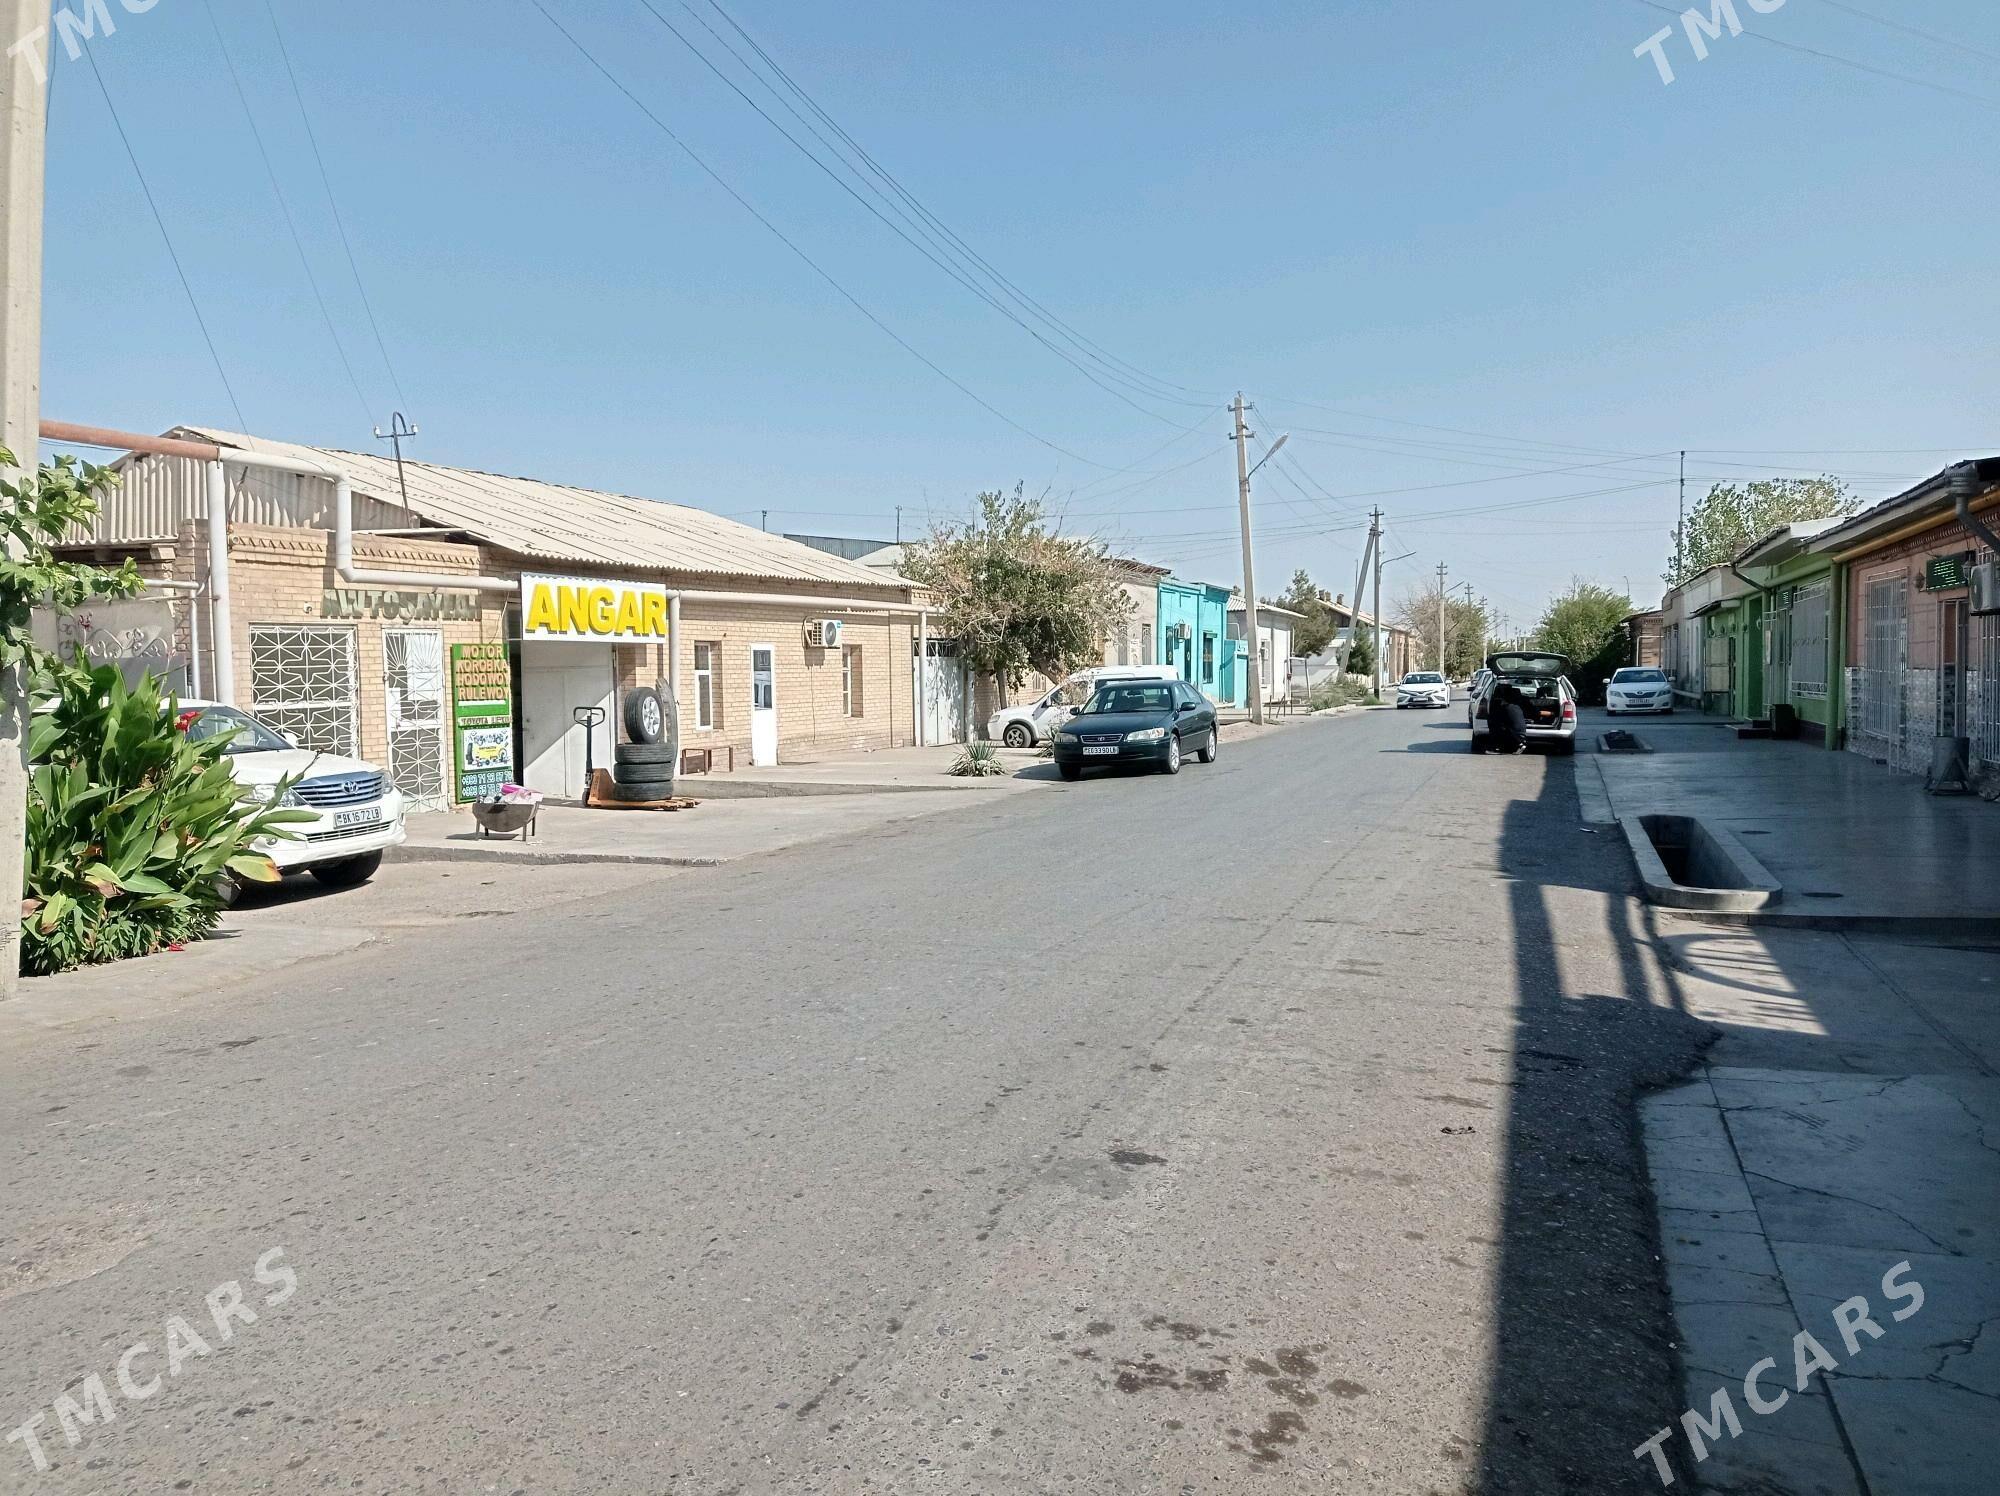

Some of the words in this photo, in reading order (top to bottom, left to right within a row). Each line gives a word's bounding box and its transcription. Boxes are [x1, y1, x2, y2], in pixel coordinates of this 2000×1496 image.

[525, 583, 668, 638] ANGAR
[461, 645, 504, 659] MOTOR
[456, 659, 508, 673] KOROBKA
[458, 687, 509, 701] RULEWOY
